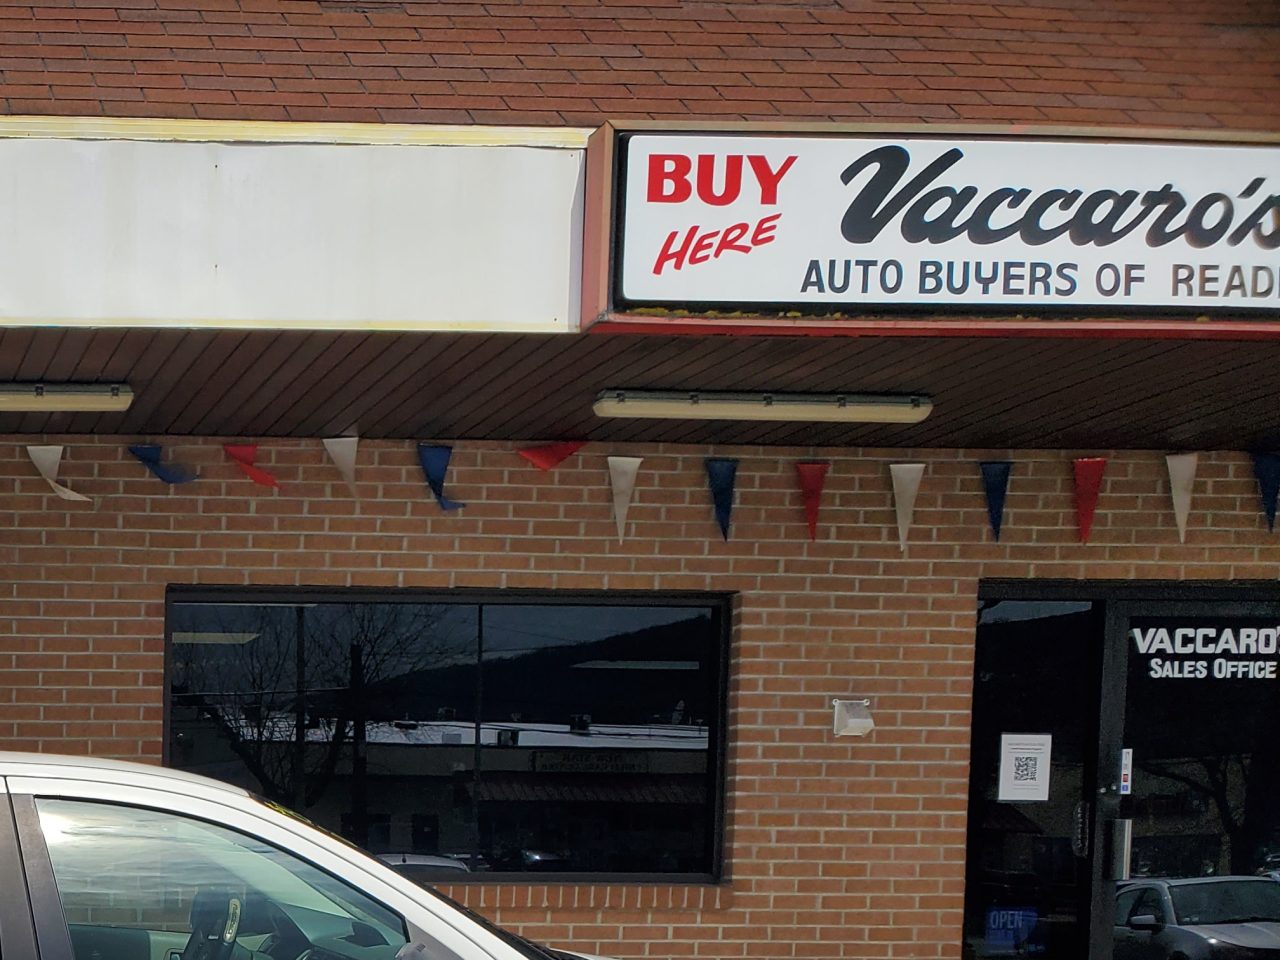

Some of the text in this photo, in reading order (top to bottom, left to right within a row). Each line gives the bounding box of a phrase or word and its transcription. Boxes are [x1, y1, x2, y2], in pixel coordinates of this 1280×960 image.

[646, 153, 799, 206] BUY
[839, 144, 1280, 251] Vaccaro's
[652, 212, 782, 275] HERE
[800, 259, 1280, 299] AUTO BUYERS OF READ
[1131, 626, 1280, 655] VACCARO'
[1150, 658, 1278, 679] SALES OFFICE
[989, 910, 1023, 929] OPEN
